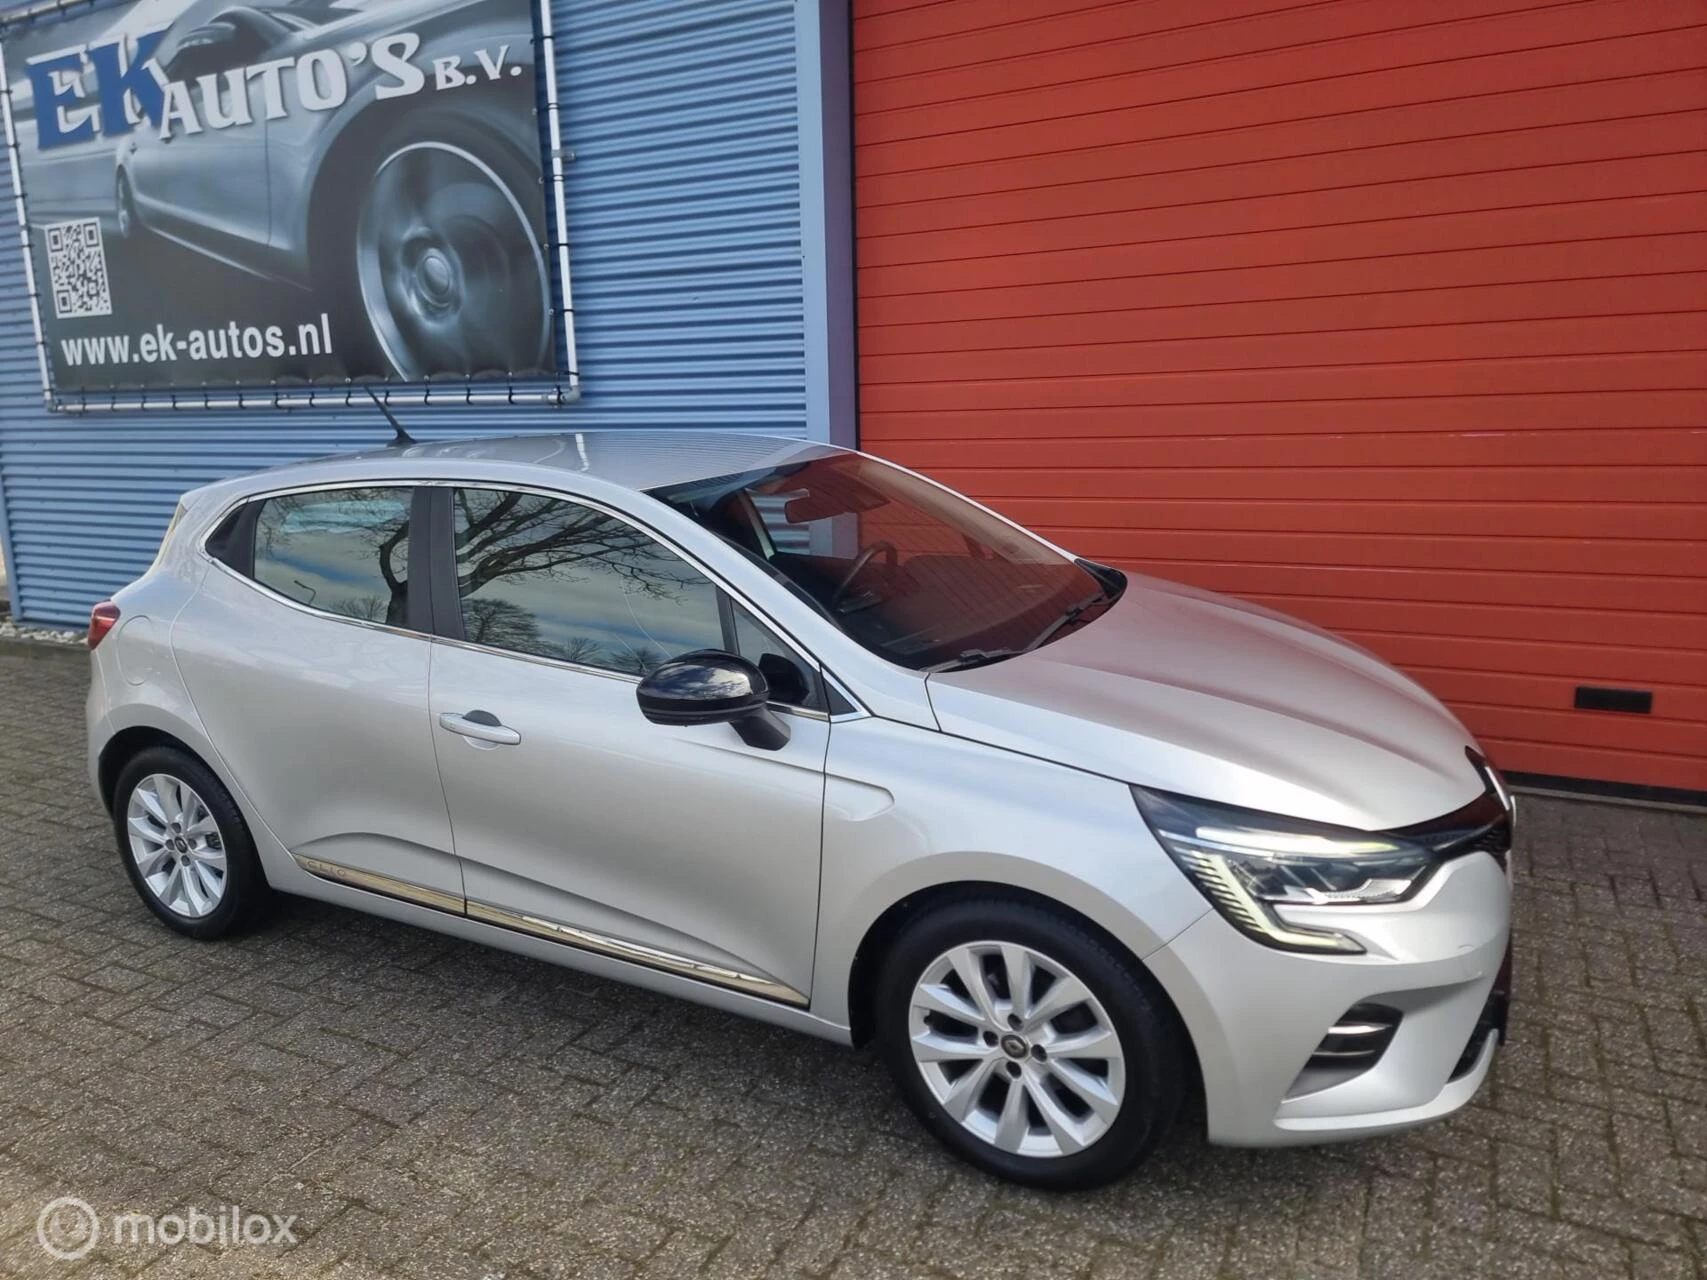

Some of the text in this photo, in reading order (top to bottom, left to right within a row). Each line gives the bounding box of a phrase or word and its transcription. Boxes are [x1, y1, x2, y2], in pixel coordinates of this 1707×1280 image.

[26, 30, 522, 150] EK AUTO'S B.V.
[61, 313, 333, 366] www.ek-autos.nl
